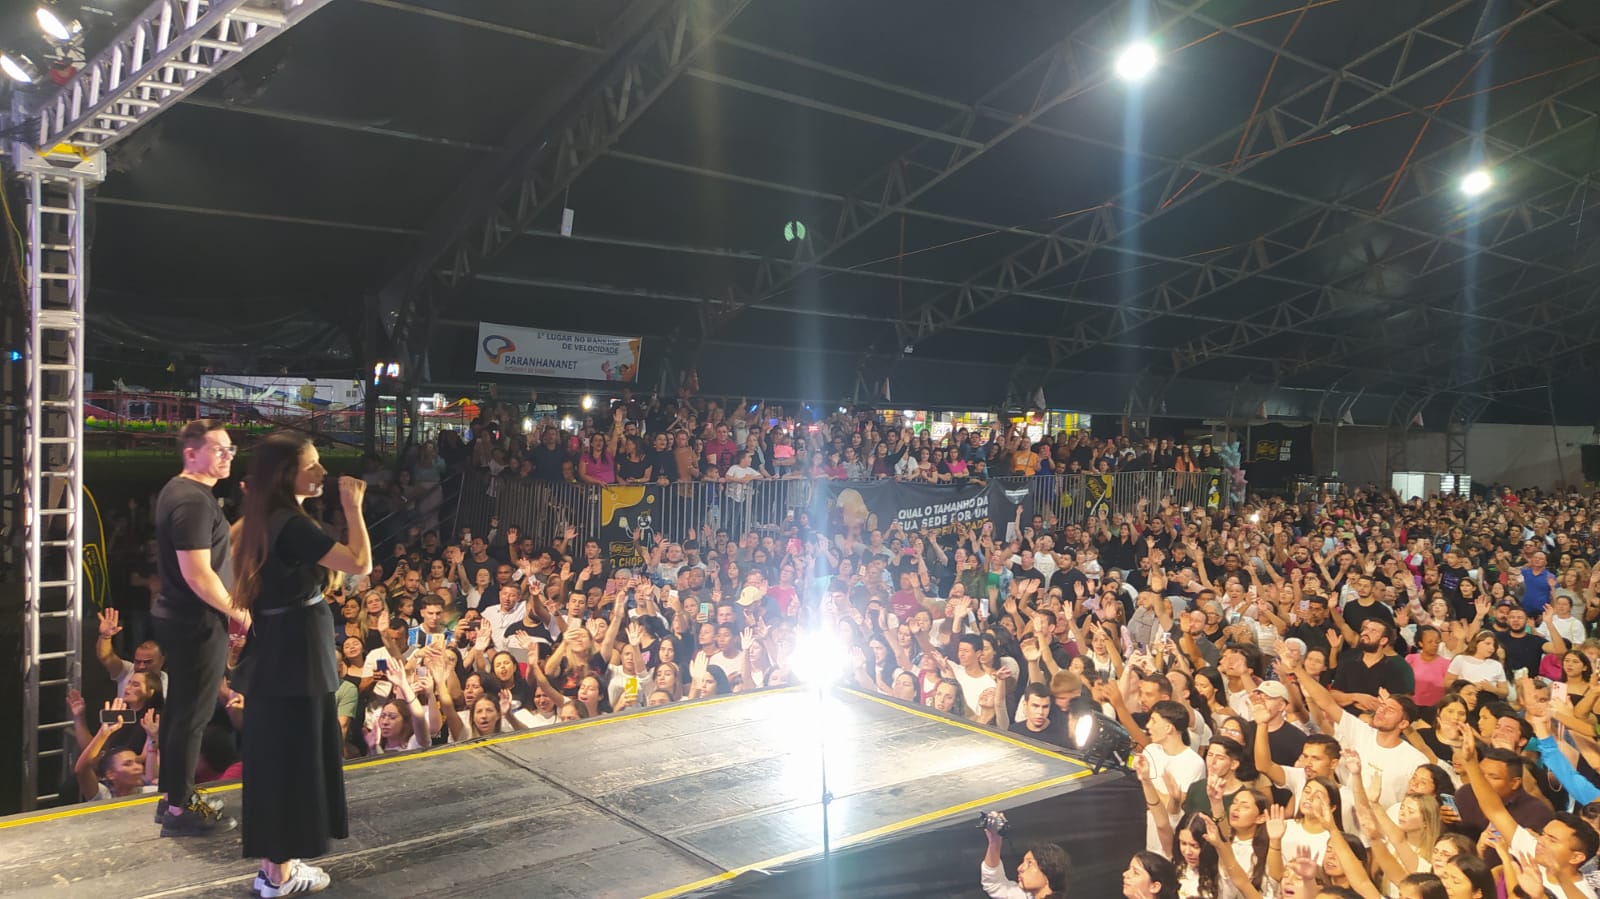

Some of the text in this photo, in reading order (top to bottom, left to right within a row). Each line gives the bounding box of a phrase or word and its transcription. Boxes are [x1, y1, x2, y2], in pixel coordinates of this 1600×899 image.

[546, 333, 573, 342] LUGAR
[562, 342, 619, 354] DE VELOCIDADE
[505, 355, 578, 370] PARANHANANET
[898, 495, 989, 520] QUAL O TAMANHO DA
[922, 515, 948, 528] SEDE
[974, 506, 988, 517] UM
